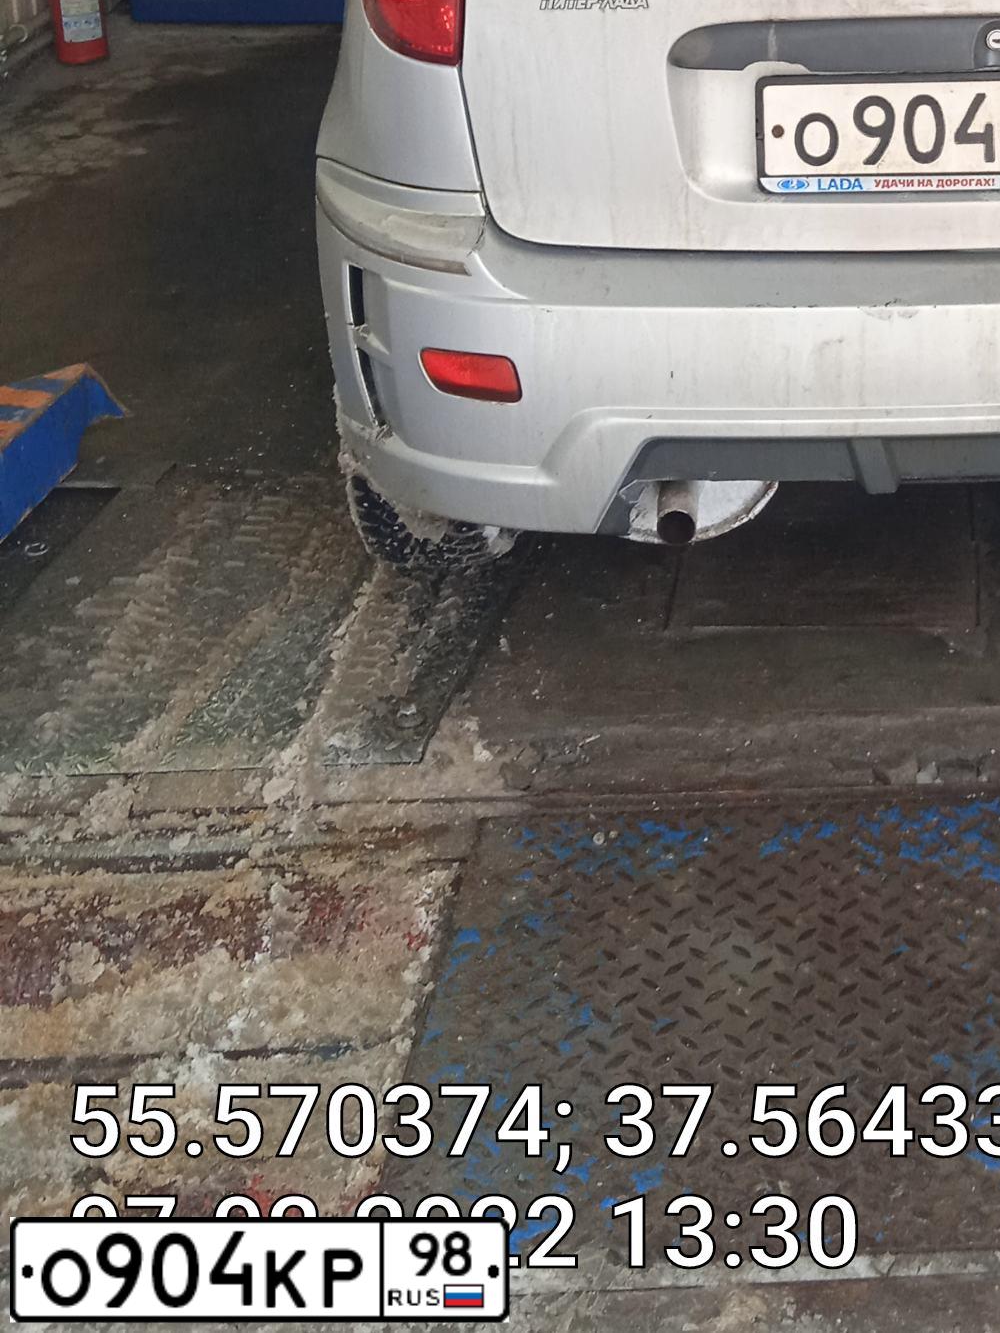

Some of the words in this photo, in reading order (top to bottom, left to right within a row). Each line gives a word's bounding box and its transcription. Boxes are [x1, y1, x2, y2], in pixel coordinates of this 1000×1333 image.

[817, 177, 864, 191] LADA
[874, 178, 914, 189] УДАЧИ
[917, 178, 934, 188] НА
[935, 178, 996, 189] ДОРОГАХ!
